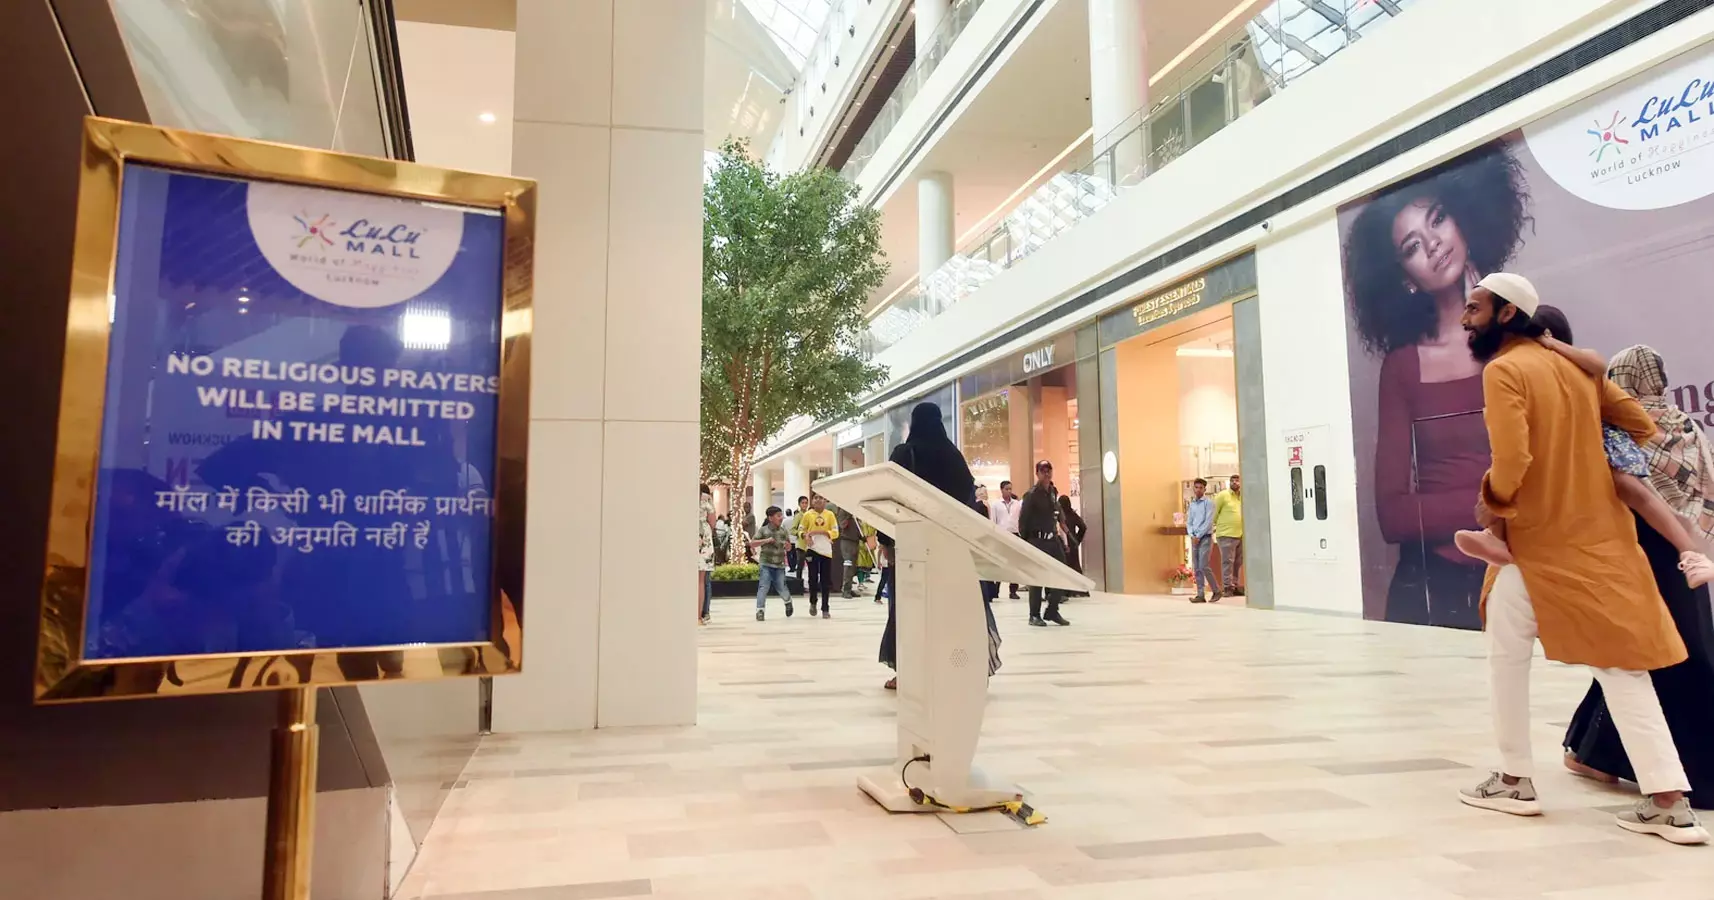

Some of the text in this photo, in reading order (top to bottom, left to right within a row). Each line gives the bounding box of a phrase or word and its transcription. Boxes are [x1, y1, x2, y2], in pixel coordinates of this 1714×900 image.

[1631, 78, 1714, 127] LuLu
[1590, 160, 1625, 179] World
[1630, 152, 1642, 165] of
[1627, 160, 1681, 185] Lucknow
[340, 219, 420, 244] LuLu
[346, 240, 420, 259] MALL
[1023, 344, 1055, 373] ONLY
[167, 353, 499, 394] NO RELIGIOUS PRAYERS
[196, 386, 475, 420] WILL BE PERMITTED
[252, 419, 426, 446] IN THE MALL
[154, 484, 209, 511] मॉल
[216, 485, 240, 512] में
[245, 486, 311, 514] किसी
[317, 488, 346, 514] भी
[354, 489, 429, 515] धार्मिक
[225, 520, 431, 553] की अनुमति नहीं है
